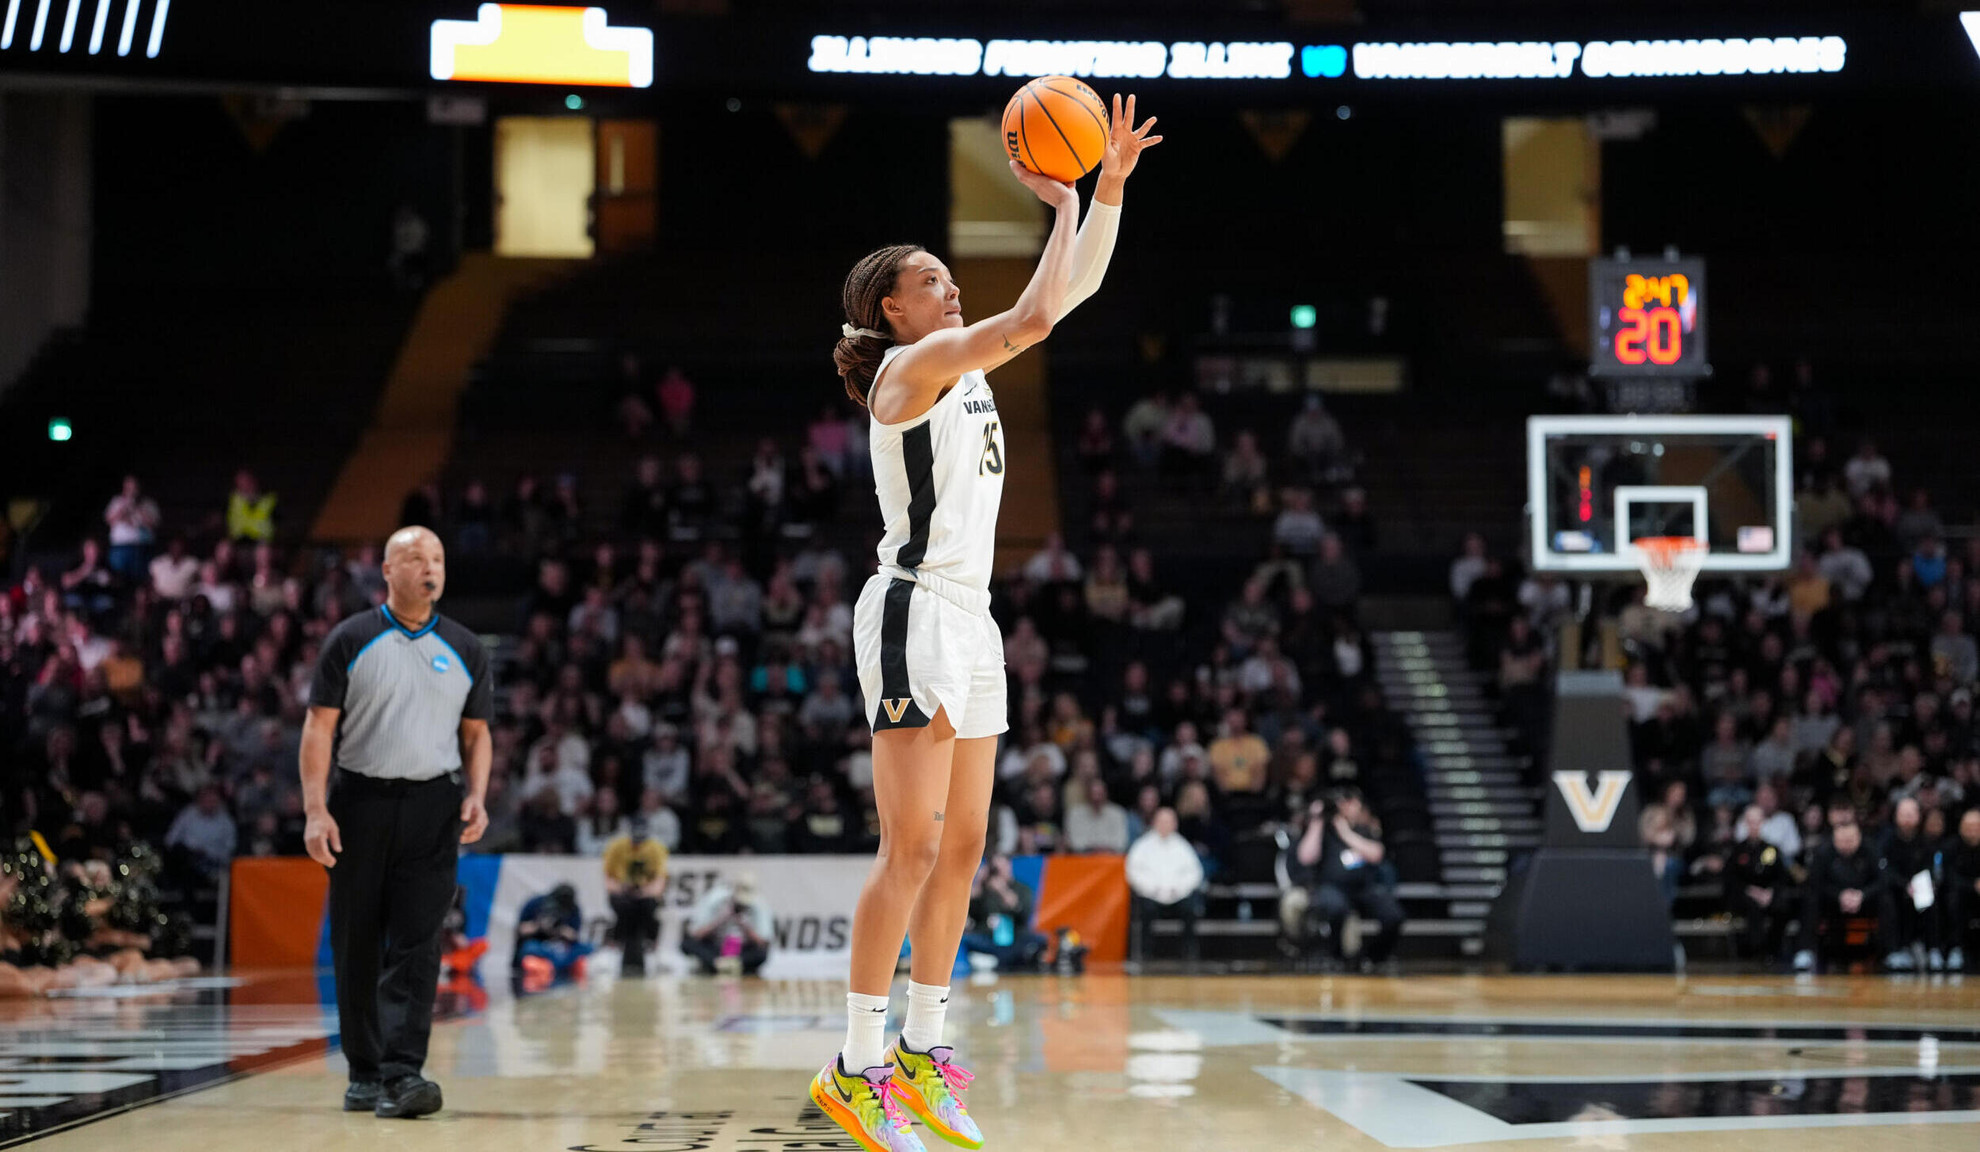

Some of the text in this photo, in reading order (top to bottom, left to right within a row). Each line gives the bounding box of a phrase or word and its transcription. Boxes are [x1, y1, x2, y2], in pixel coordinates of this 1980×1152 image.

[1614, 306, 1682, 365] 20
[979, 421, 1003, 476] 15
[881, 697, 912, 723] V
[1552, 770, 1633, 832] V
